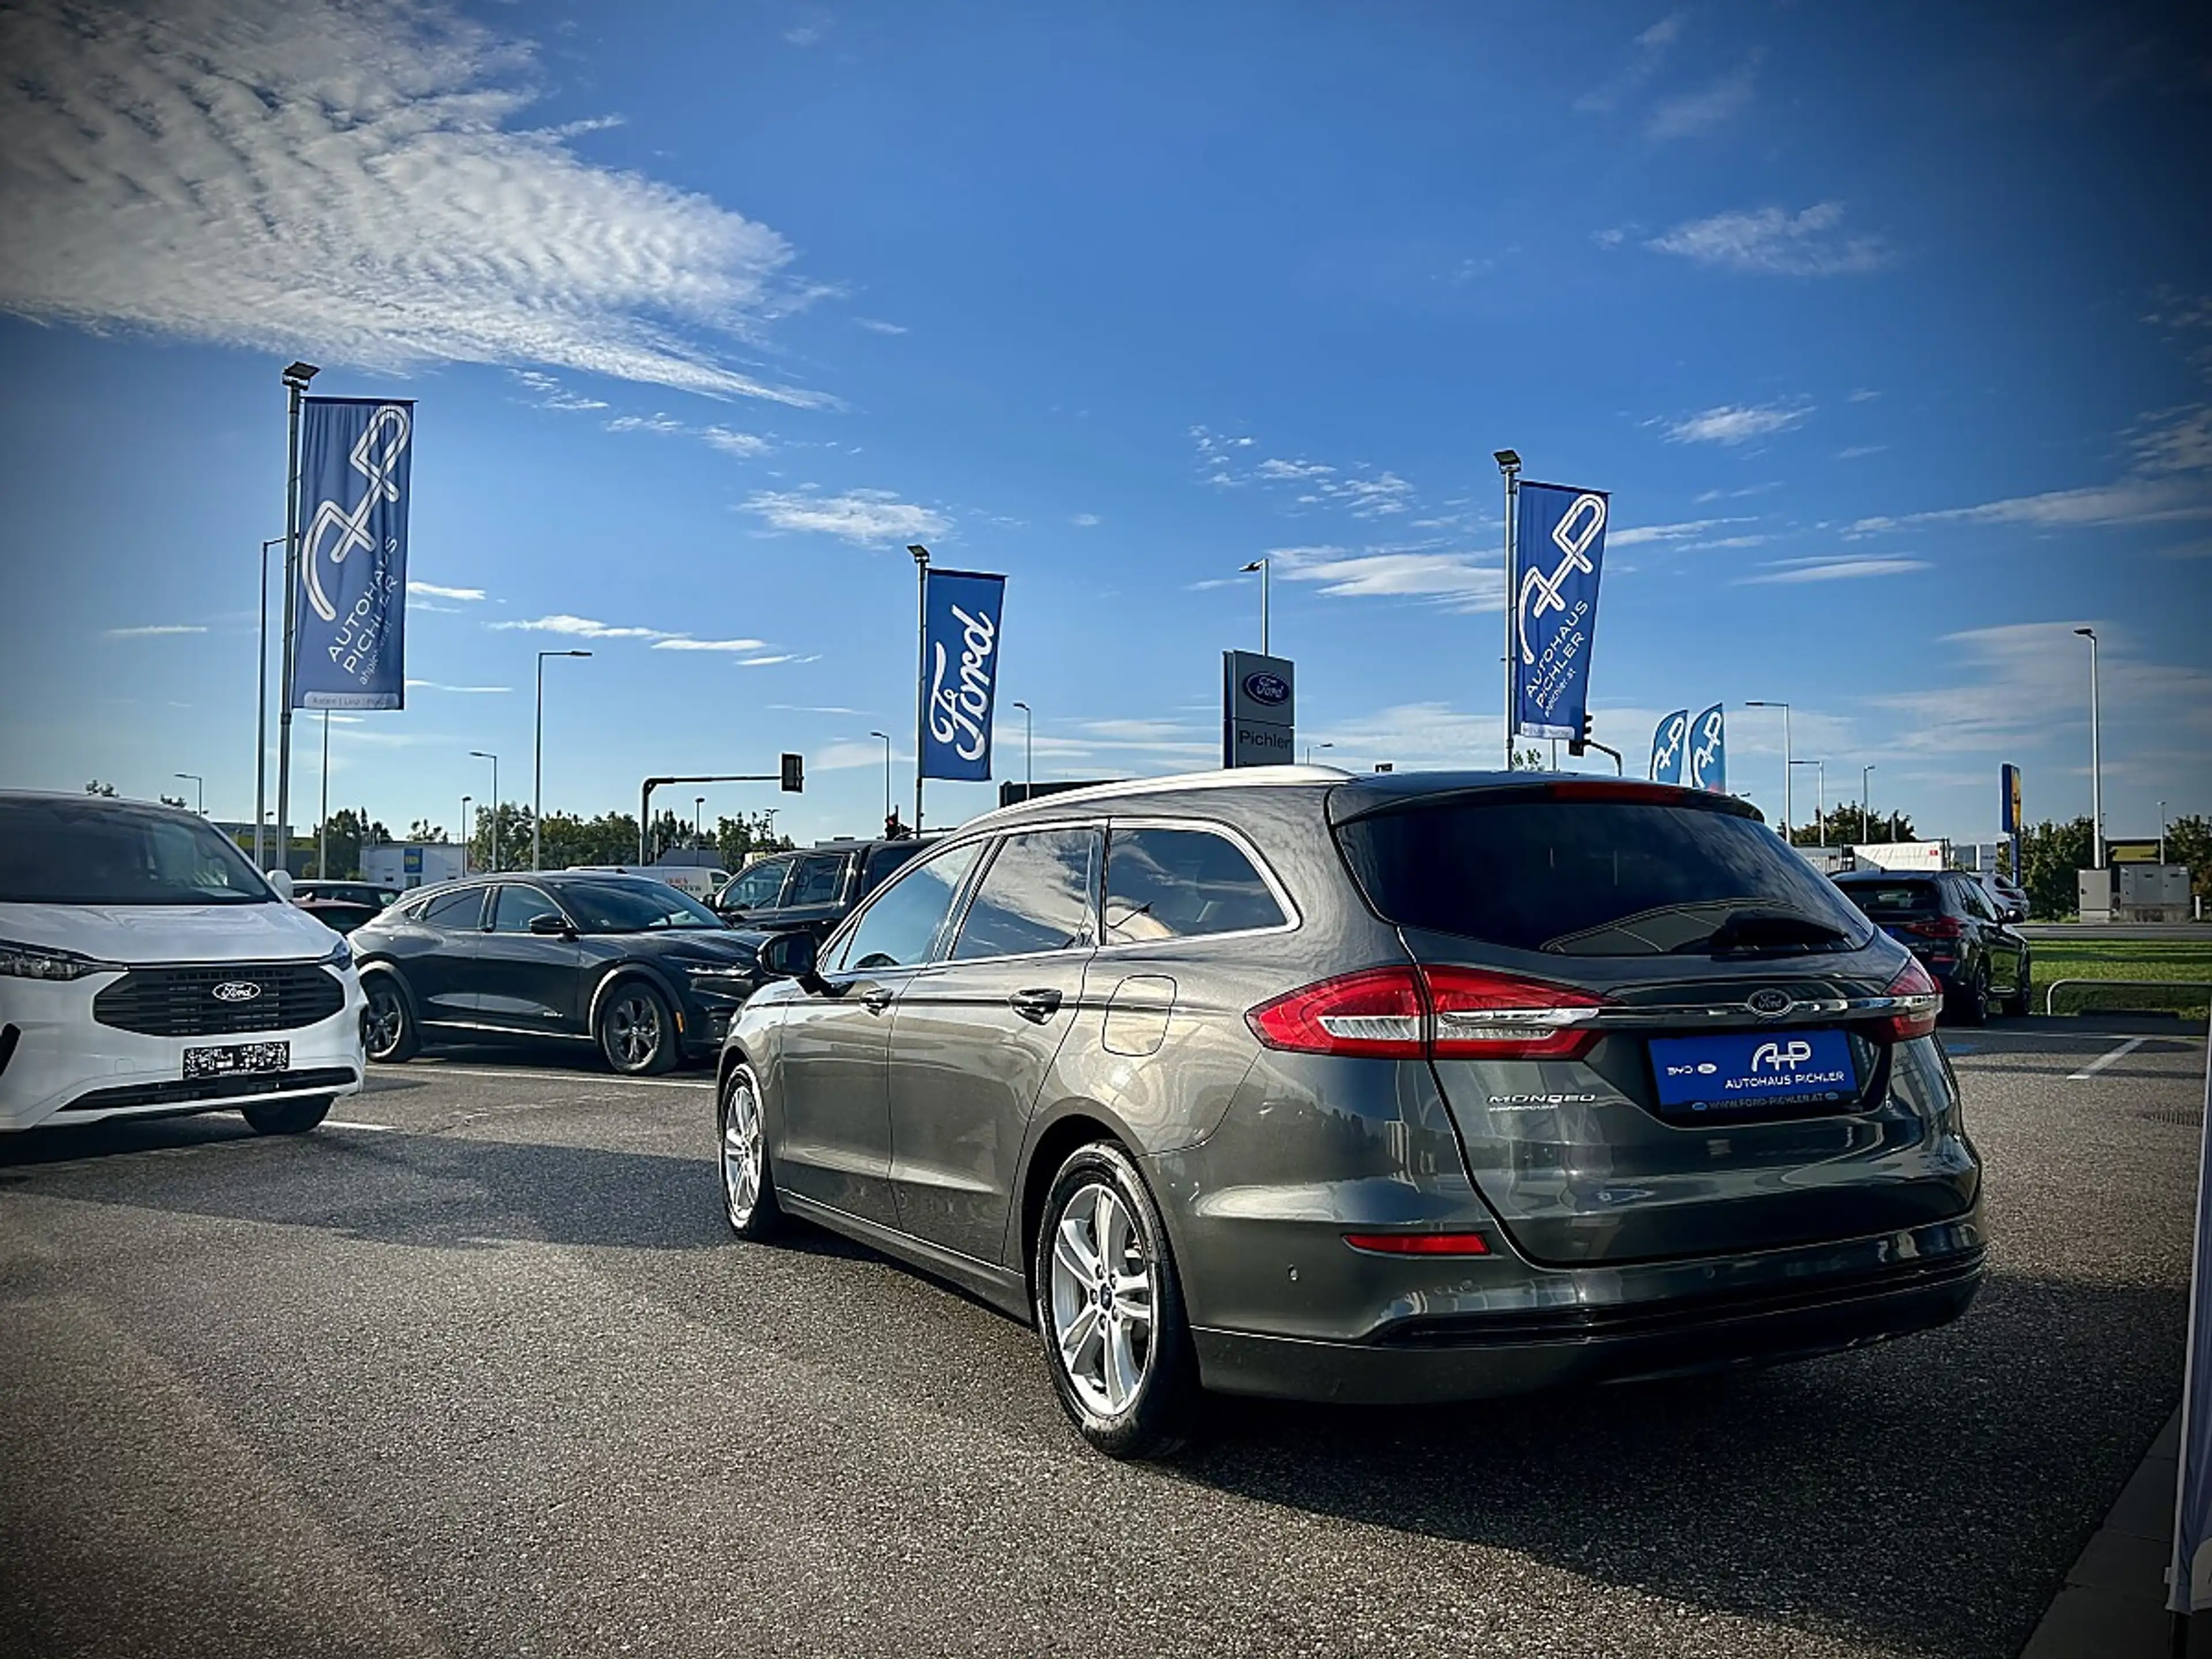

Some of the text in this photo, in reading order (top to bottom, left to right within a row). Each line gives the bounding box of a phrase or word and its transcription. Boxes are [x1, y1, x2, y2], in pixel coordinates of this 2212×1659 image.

[1526, 600, 1589, 699] AUTOHAUS
[1535, 631, 1585, 709] PICHLER
[929, 604, 995, 760] Ford
[1256, 676, 1285, 698] Ford
[1239, 729, 1291, 749] Pichler
[221, 984, 252, 999] Ford
[1758, 995, 1782, 1009] Ford
[1725, 1070, 1846, 1090] AUTOHAUS PICHLER
